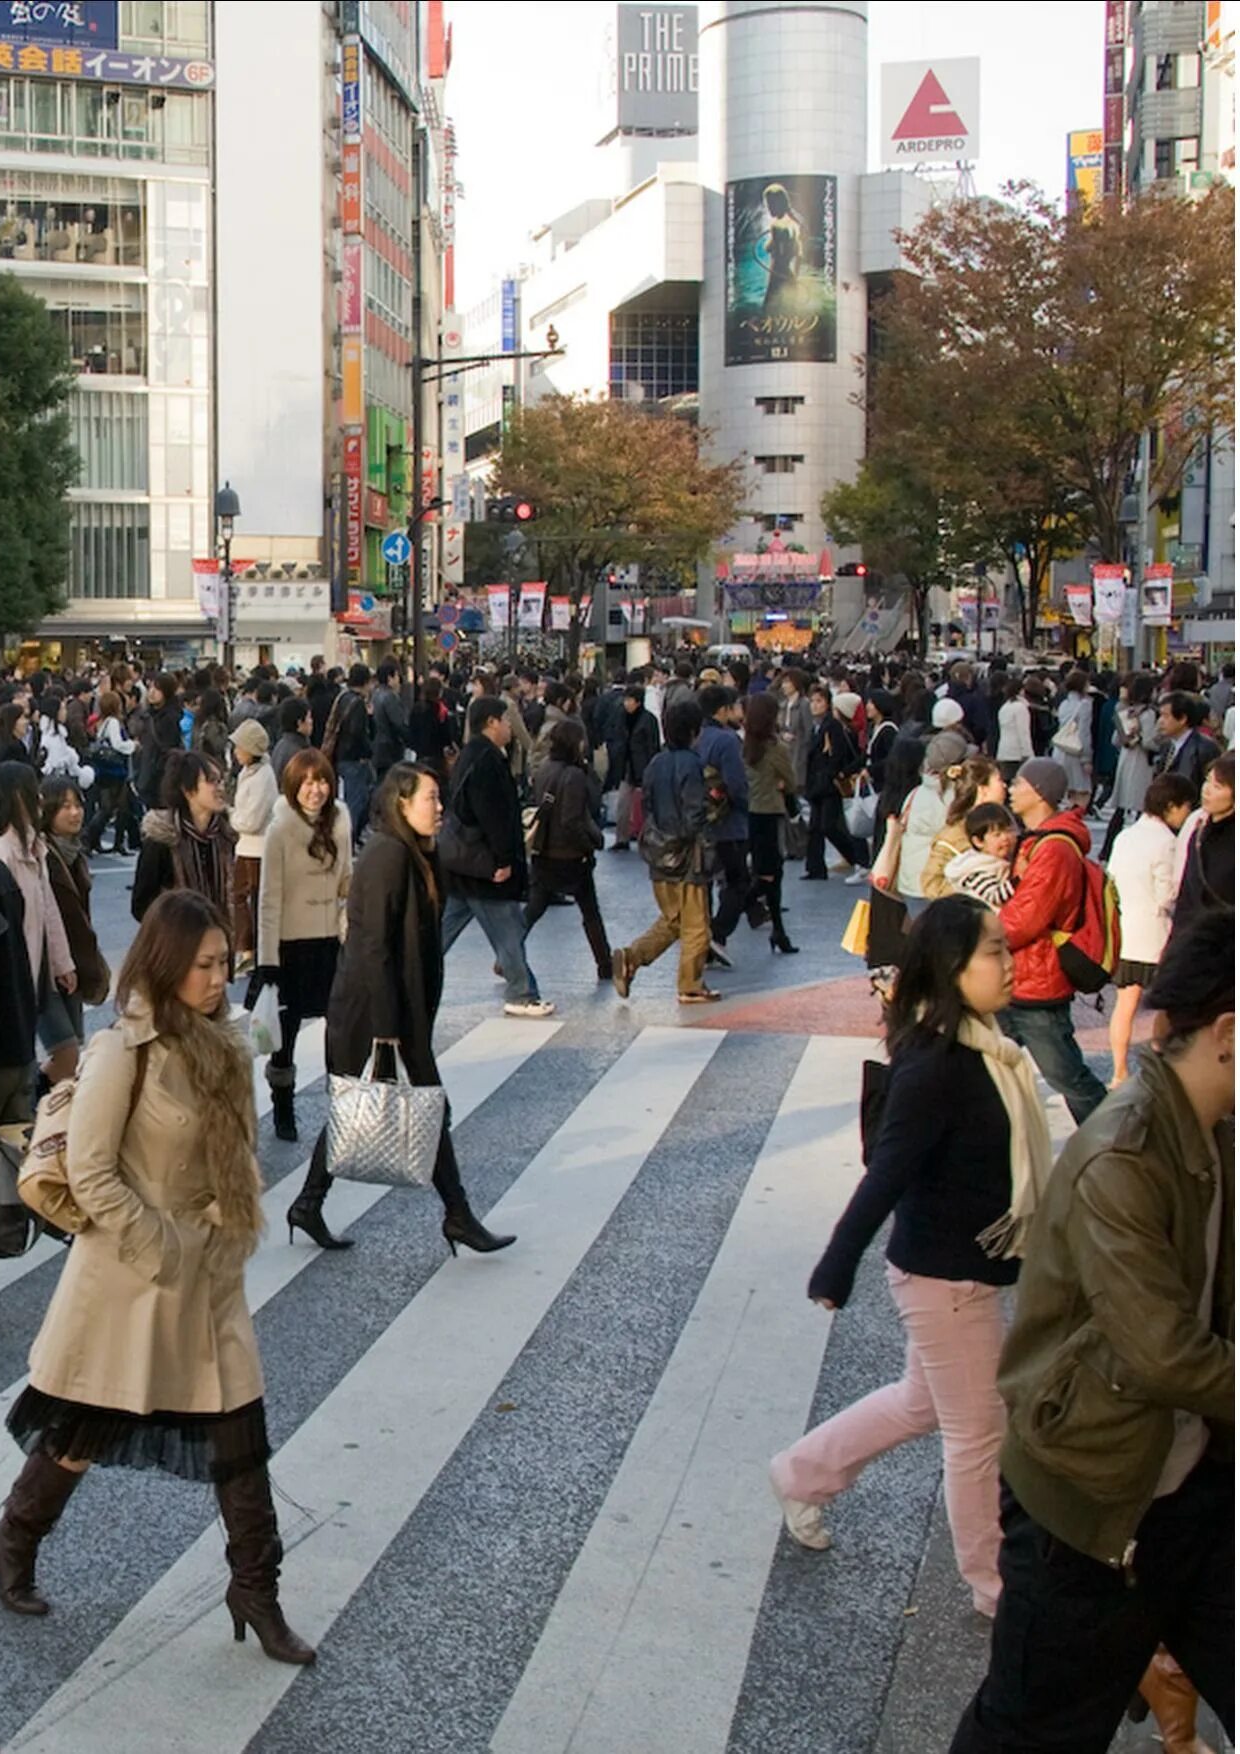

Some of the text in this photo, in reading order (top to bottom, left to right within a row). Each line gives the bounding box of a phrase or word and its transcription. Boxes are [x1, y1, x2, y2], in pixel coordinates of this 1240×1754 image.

[640, 12, 684, 51] THE
[186, 65, 210, 82] 6F
[624, 53, 699, 92] PRIME
[895, 138, 966, 154] ARDEPRO
